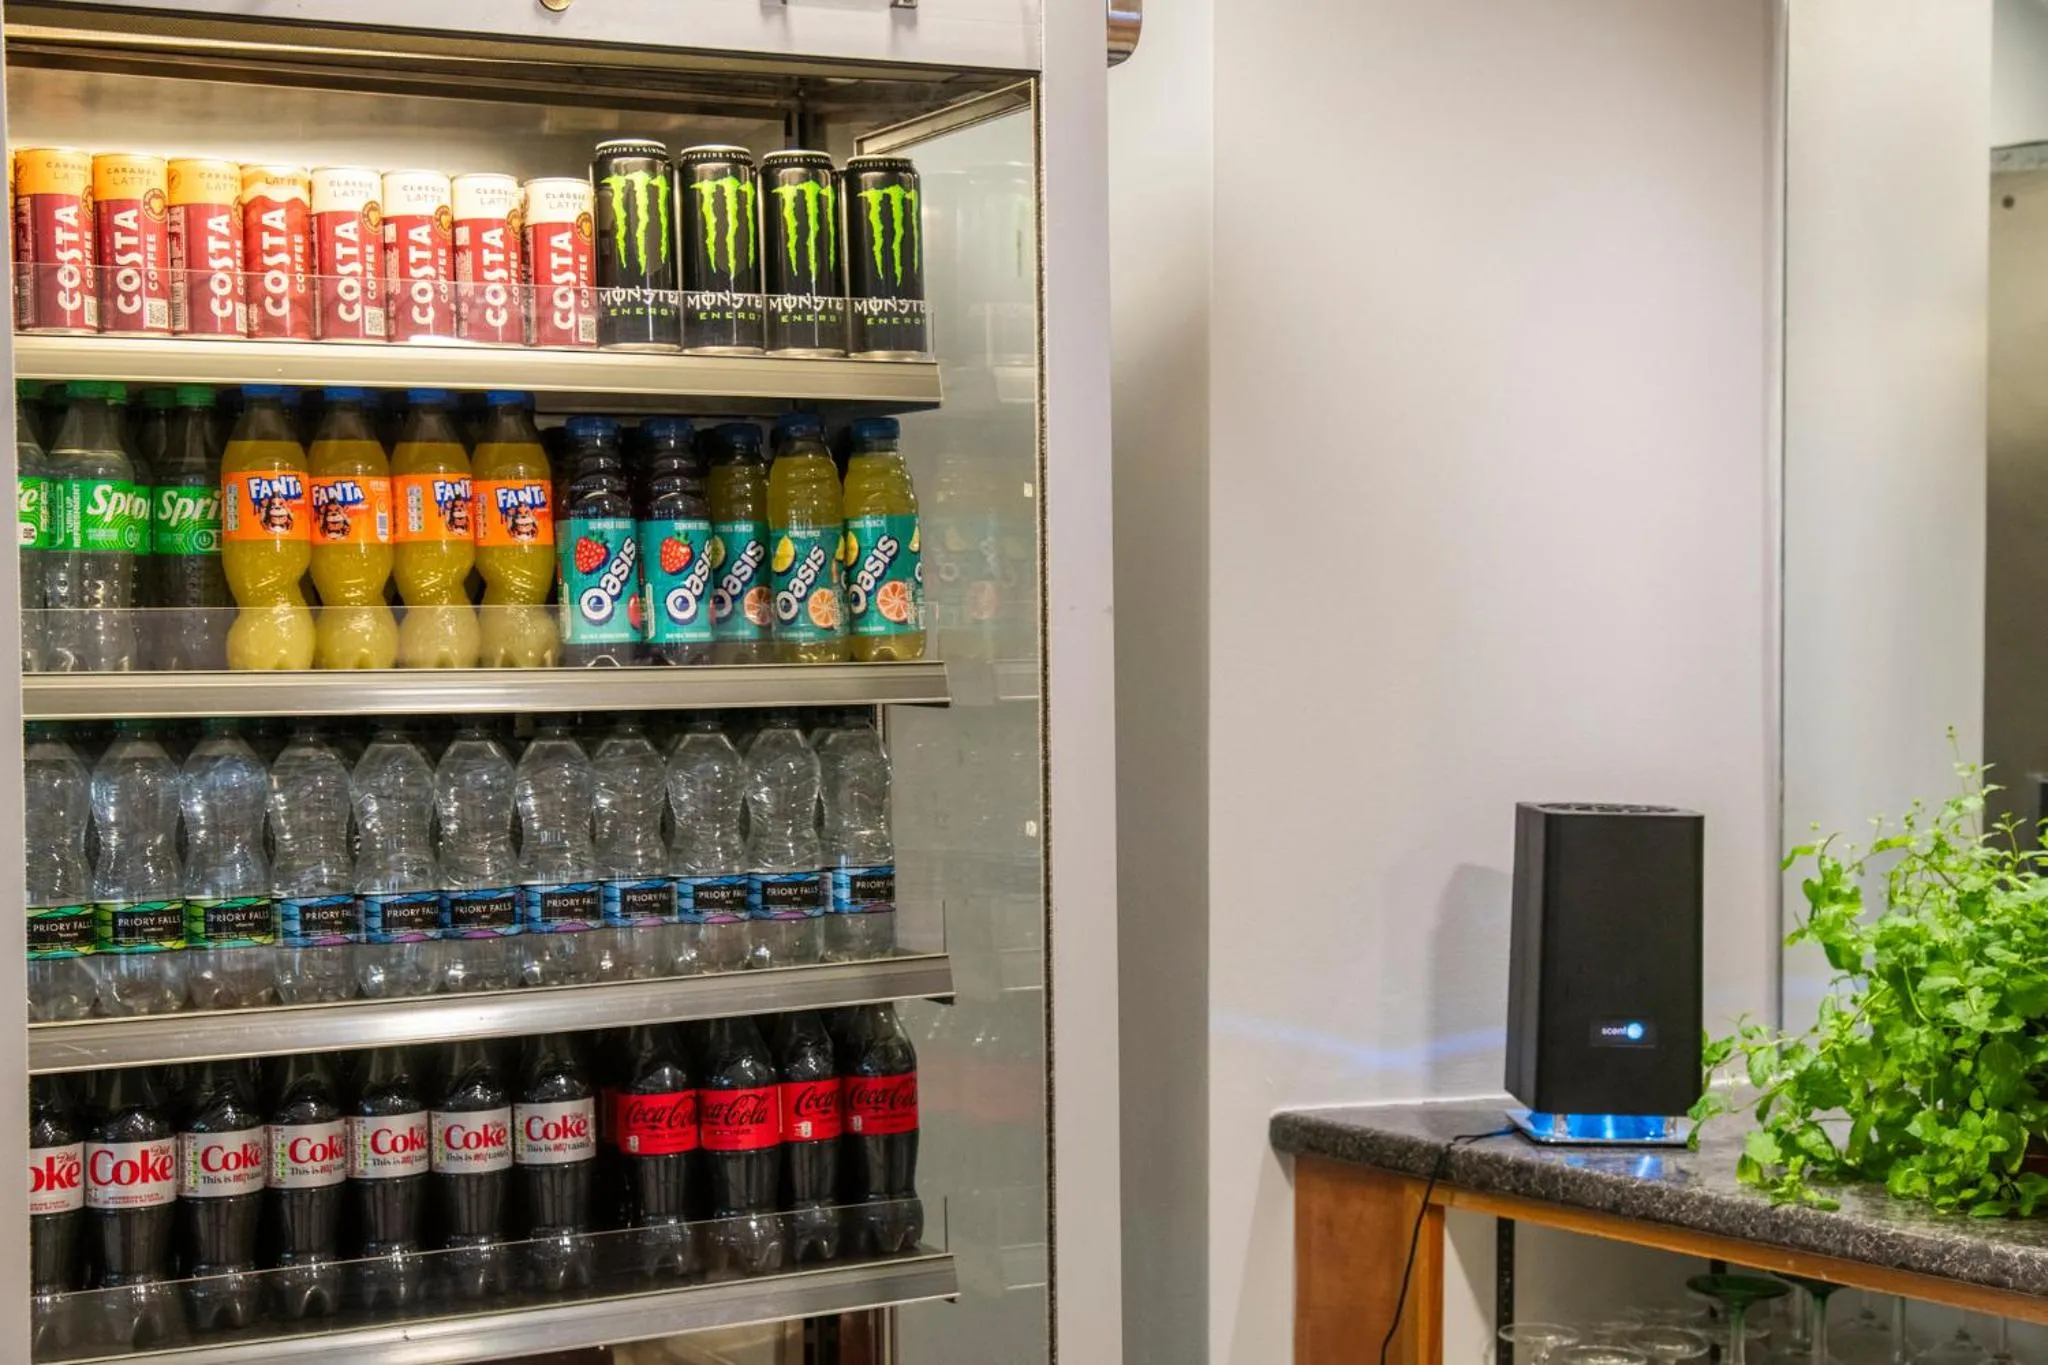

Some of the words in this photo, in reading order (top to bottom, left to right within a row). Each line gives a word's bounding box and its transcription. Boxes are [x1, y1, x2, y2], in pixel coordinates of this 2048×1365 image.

[106, 167, 158, 176] CARAMEL
[265, 176, 298, 186] LATTE
[54, 204, 83, 312] COSTA
[113, 208, 144, 315] COSTA
[146, 234, 159, 291] COFFEE
[207, 213, 234, 318] COSTA
[261, 208, 290, 317] COSTA
[293, 233, 306, 295] COFFEE
[335, 219, 363, 323] COSTA
[365, 244, 377, 300] COFFEE
[408, 223, 437, 326] COSTA
[437, 247, 449, 304] COFFEE
[481, 226, 509, 329] COSTA
[509, 251, 520, 306] COFFEE
[550, 230, 577, 331] COSTA
[578, 254, 590, 309] COFFEE
[310, 481, 365, 505] FANTA
[580, 537, 637, 622] Oasis
[709, 540, 765, 619] Oasis
[776, 545, 826, 622] Oasis
[848, 535, 898, 615] Oasis
[546, 898, 580, 908] PRIORY
[626, 894, 658, 902] PRIORY
[698, 890, 731, 900] PRIORY
[766, 887, 798, 897] PRIORY
[855, 880, 885, 889] PRIORY
[33, 921, 71, 932] PRIORY
[118, 917, 155, 927] PRIORY
[209, 912, 247, 922] PRIORY
[305, 909, 340, 920] PRIORY
[386, 907, 420, 918] PRIORY
[455, 904, 487, 914] PRIORY
[444, 1123, 507, 1151] Coke
[525, 1115, 589, 1142] Coke
[88, 1149, 174, 1187] Coke
[202, 1174, 222, 1185] This
[223, 1174, 232, 1184] is
[290, 1166, 309, 1177] This
